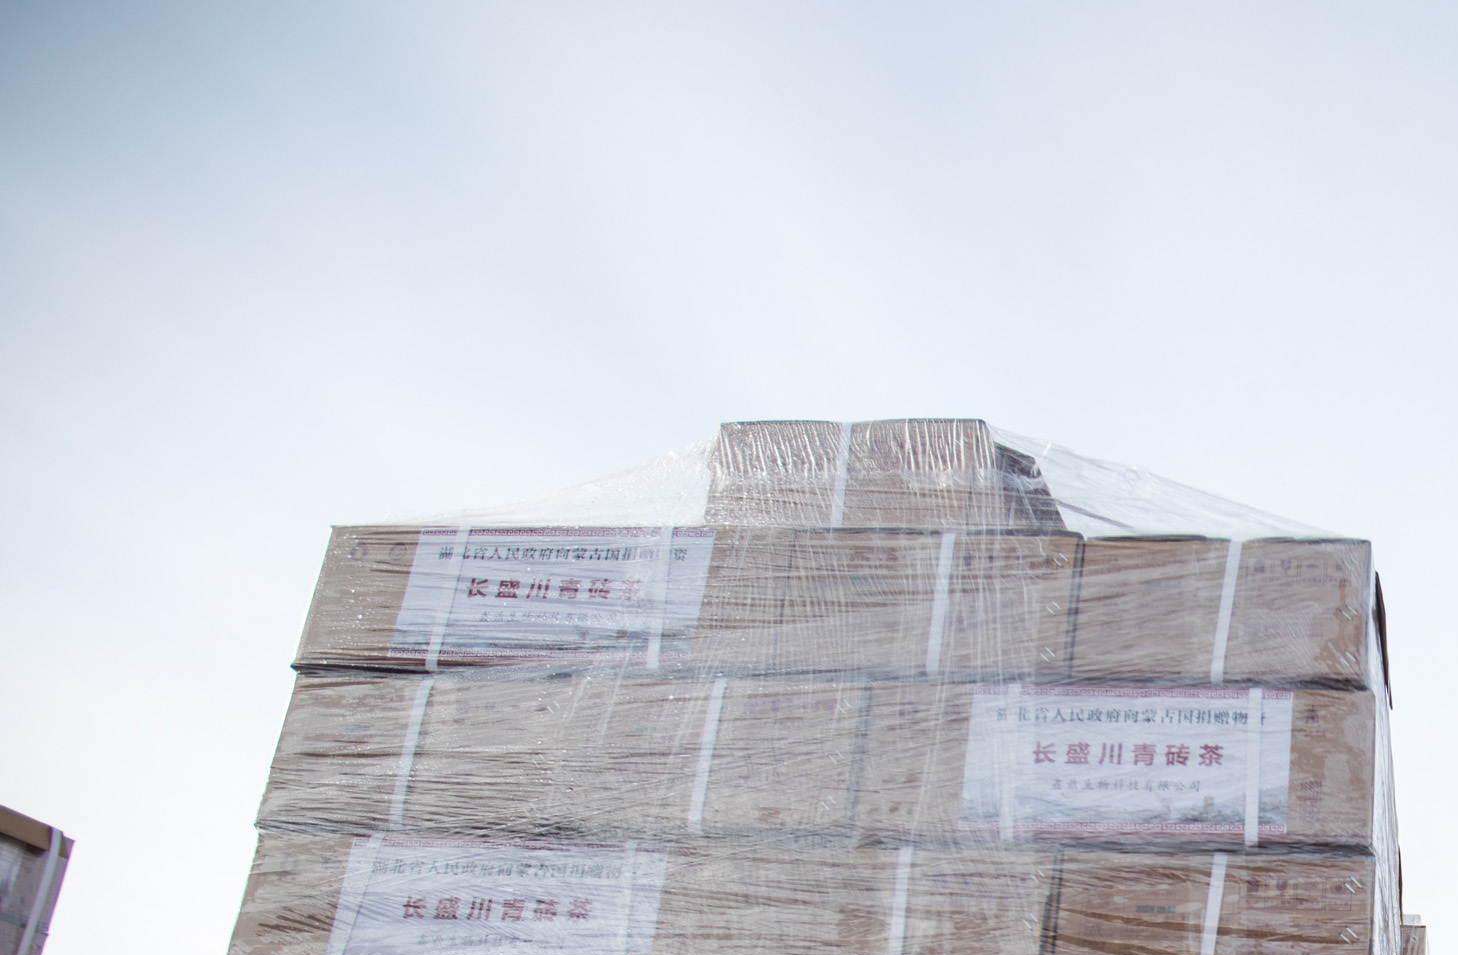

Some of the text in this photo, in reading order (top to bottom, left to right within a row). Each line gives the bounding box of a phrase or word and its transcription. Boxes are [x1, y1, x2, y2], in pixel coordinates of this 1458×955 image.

[466, 577, 644, 600] 长盛川青砖茶
[1032, 741, 1224, 767] 长盛川青砖茶
[401, 895, 593, 921] 长盛川青砖茶
